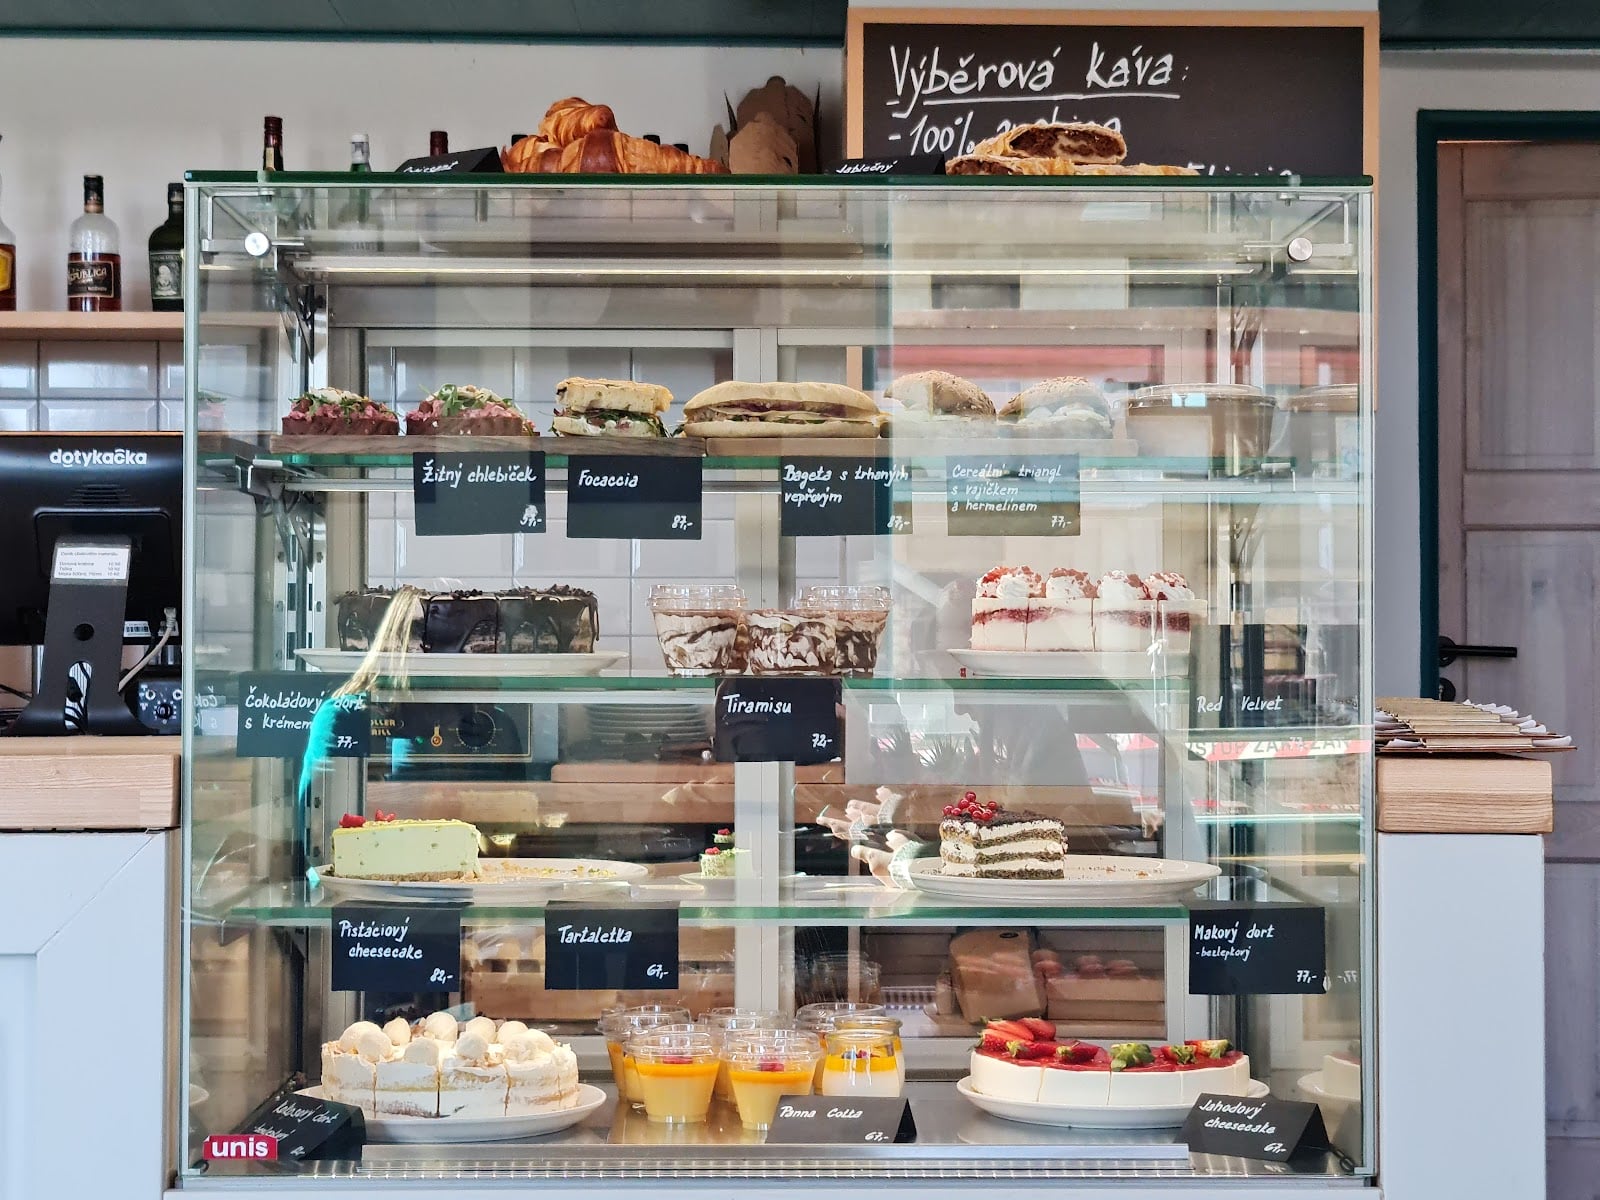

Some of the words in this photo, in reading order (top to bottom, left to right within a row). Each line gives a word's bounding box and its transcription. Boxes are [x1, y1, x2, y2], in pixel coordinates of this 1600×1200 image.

[889, 45, 1061, 118] Výběrová
[49, 448, 147, 468] dotykačka
[422, 459, 463, 488] Žitný
[467, 463, 537, 484] chlebíček
[578, 469, 639, 488] Focaccia
[782, 464, 832, 489] Bageta
[839, 469, 849, 481] s
[854, 463, 909, 488] trhaným
[1018, 463, 1062, 484] triangl
[784, 487, 843, 508] vepřovým
[951, 484, 958, 496] s
[965, 480, 1019, 500] vajíčkem
[951, 500, 959, 512] a
[965, 498, 1038, 512] hermelínem
[245, 685, 324, 714] Čokoládový
[722, 693, 792, 715] Tiramisu
[1196, 695, 1223, 712] Red
[1241, 695, 1284, 712] Velvet
[245, 717, 253, 729] s
[338, 916, 410, 942] Pistáciový
[557, 923, 633, 944] Tartaletka
[1194, 921, 1240, 943] Makový
[1246, 922, 1275, 939] dort
[348, 943, 423, 960] cheesecake
[780, 1105, 817, 1118] Panna
[826, 1107, 864, 1119] Cotta
[1199, 1099, 1267, 1120] Jahodový
[1204, 1117, 1277, 1134] cheesecake
[211, 1137, 269, 1157] unis
